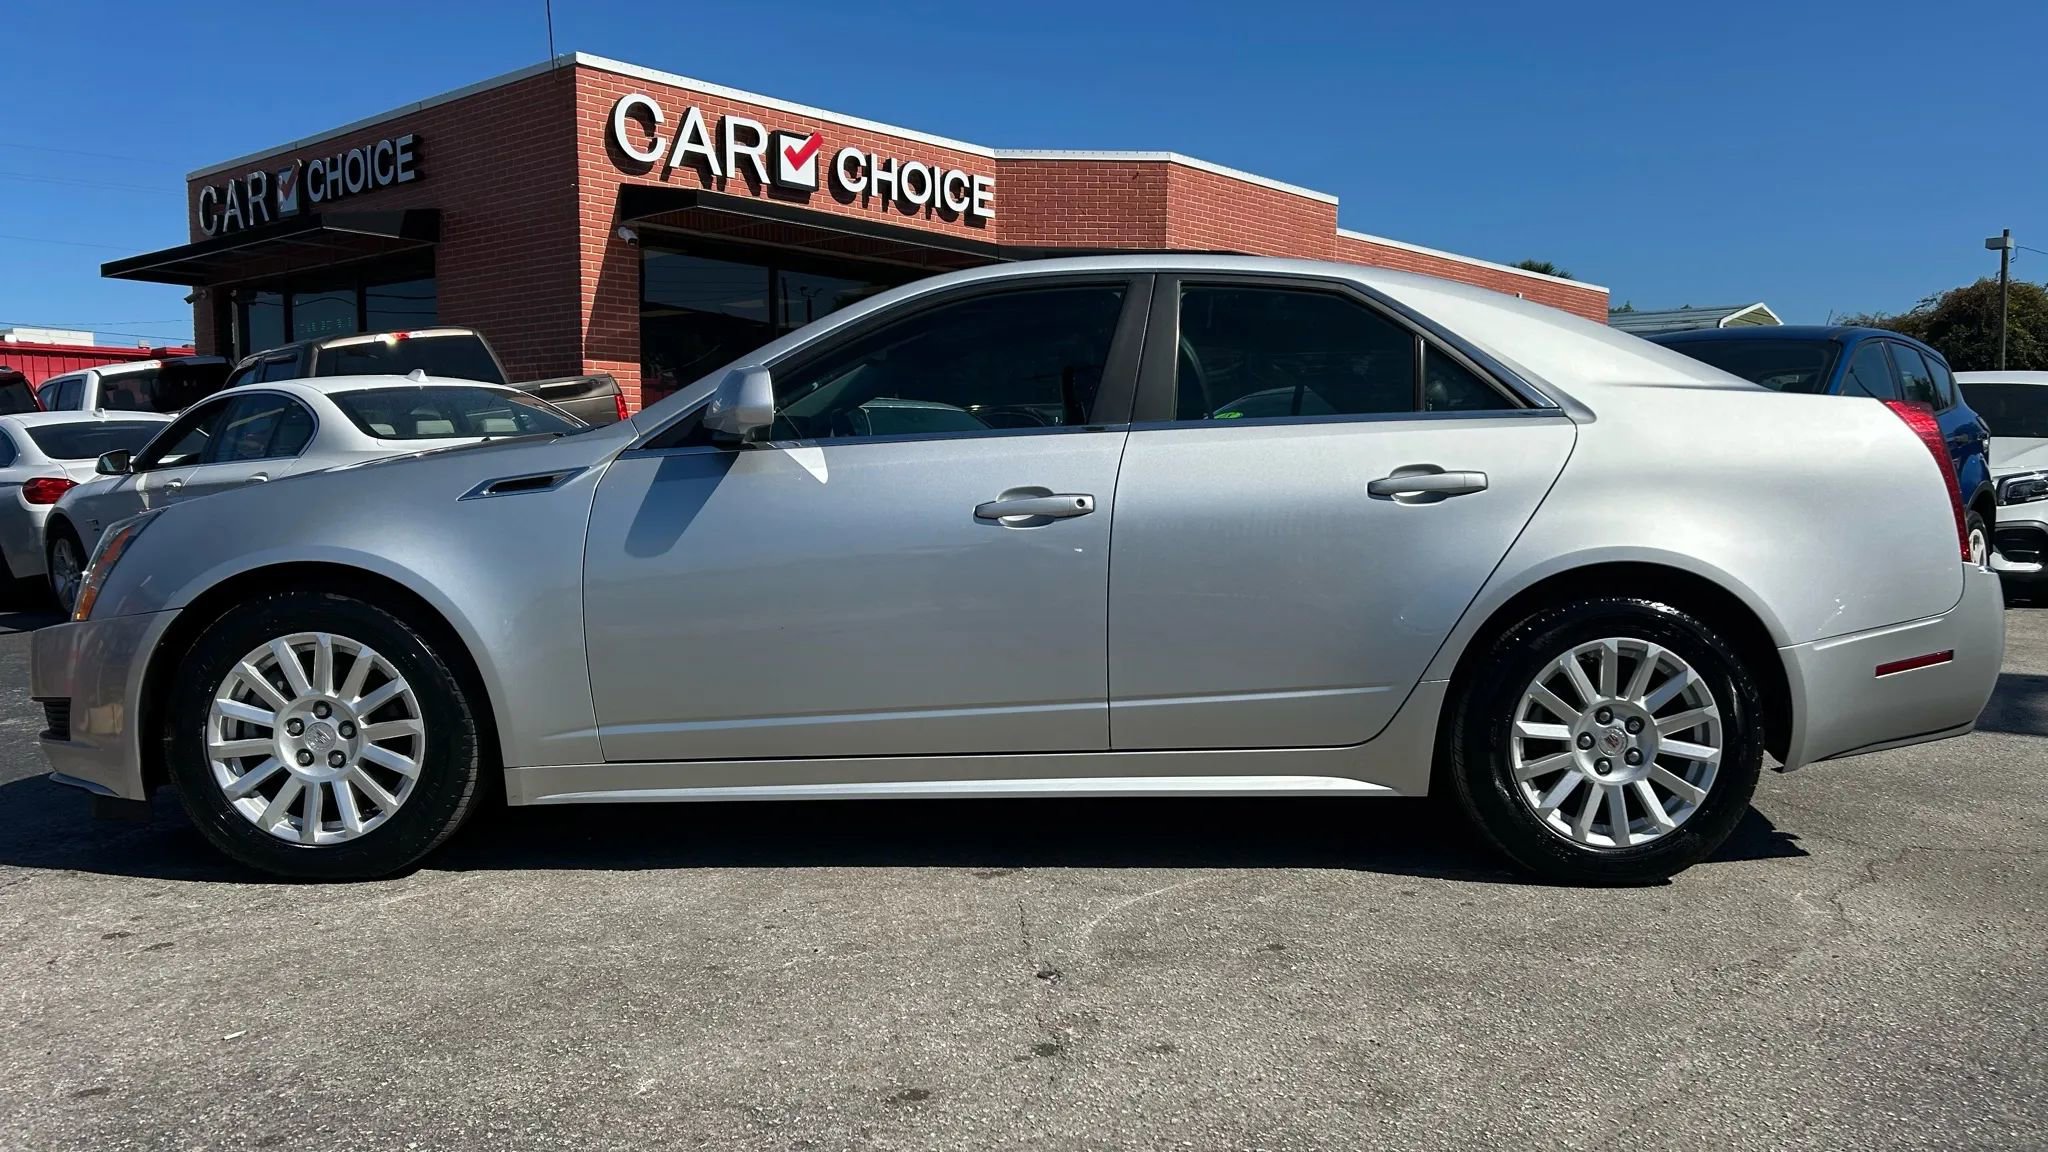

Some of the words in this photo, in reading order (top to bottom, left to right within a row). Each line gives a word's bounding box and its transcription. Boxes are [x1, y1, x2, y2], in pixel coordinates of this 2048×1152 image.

[199, 170, 270, 236] CAR
[307, 133, 416, 203] CHOICE
[614, 93, 771, 185] CAR
[836, 147, 996, 218] CHOICE
